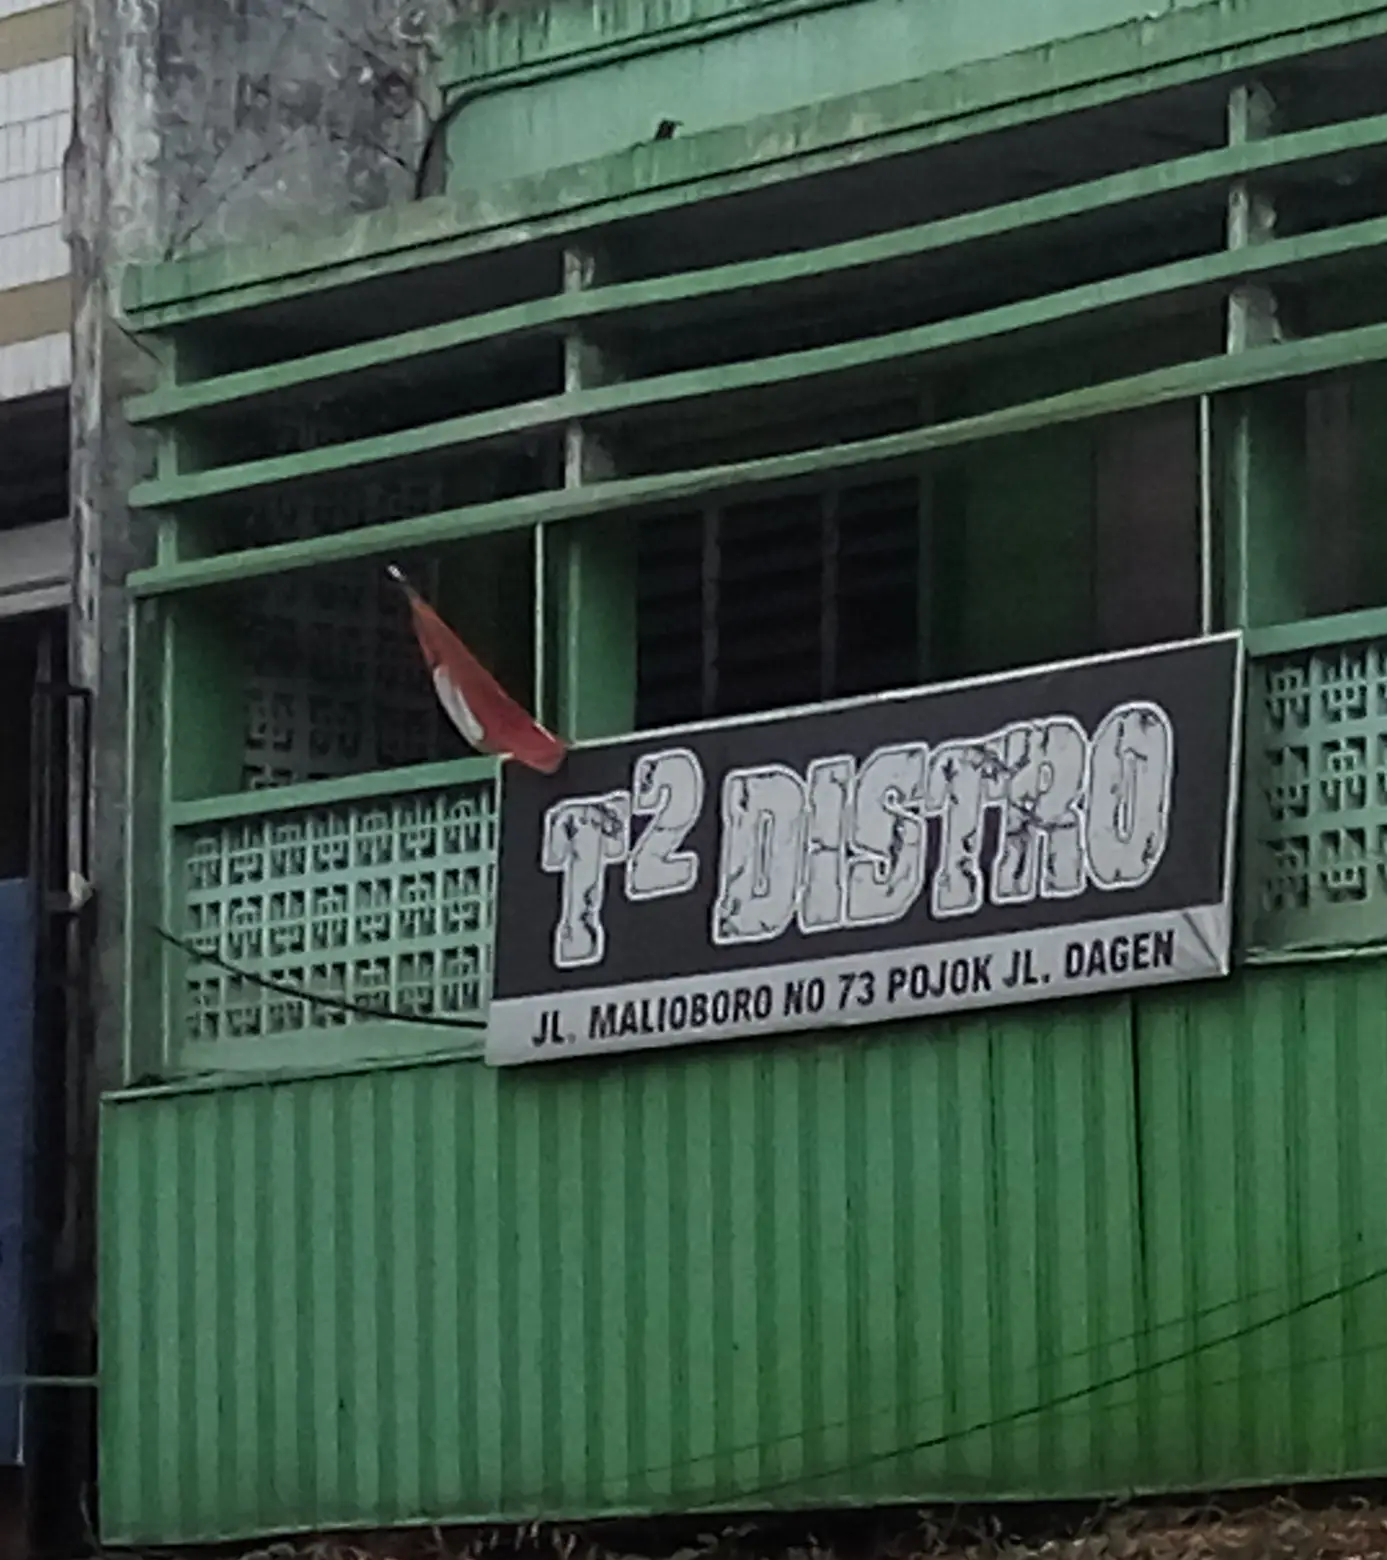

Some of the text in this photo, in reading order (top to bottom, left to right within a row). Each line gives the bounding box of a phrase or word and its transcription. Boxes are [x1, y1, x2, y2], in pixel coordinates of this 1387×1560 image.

[711, 699, 1174, 945] DISTRO
[531, 928, 1176, 1048] JL. MALIOBORO NO 73 POJOK JL. DAGEN
